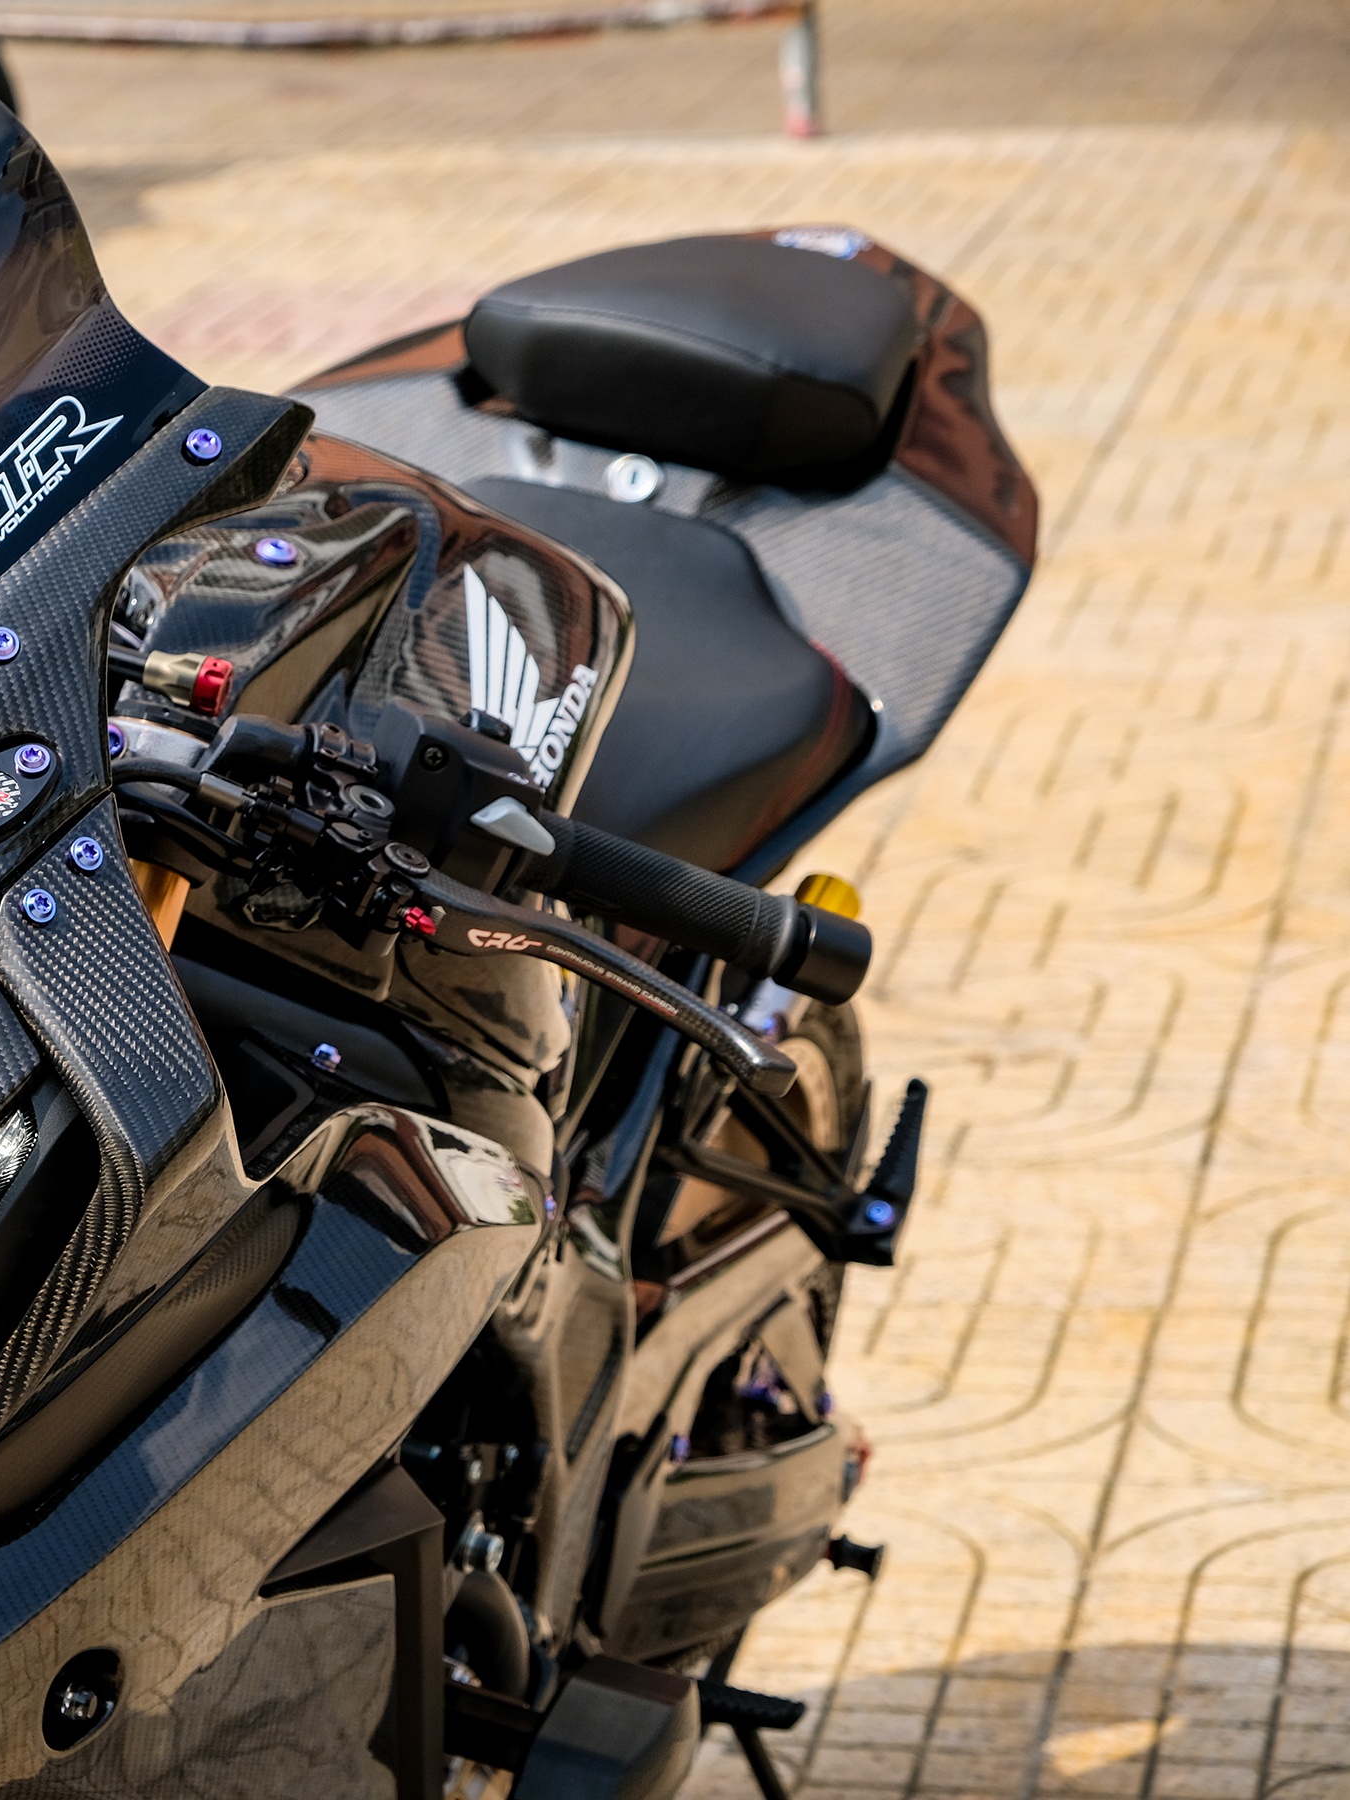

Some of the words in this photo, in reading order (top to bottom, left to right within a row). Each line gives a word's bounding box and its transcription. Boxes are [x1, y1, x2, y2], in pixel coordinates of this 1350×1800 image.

[529, 664, 599, 792] HONDA
[546, 944, 605, 975] CONTINUOUS
[605, 970, 642, 995] STRAND
[642, 989, 679, 1016] CARBON
